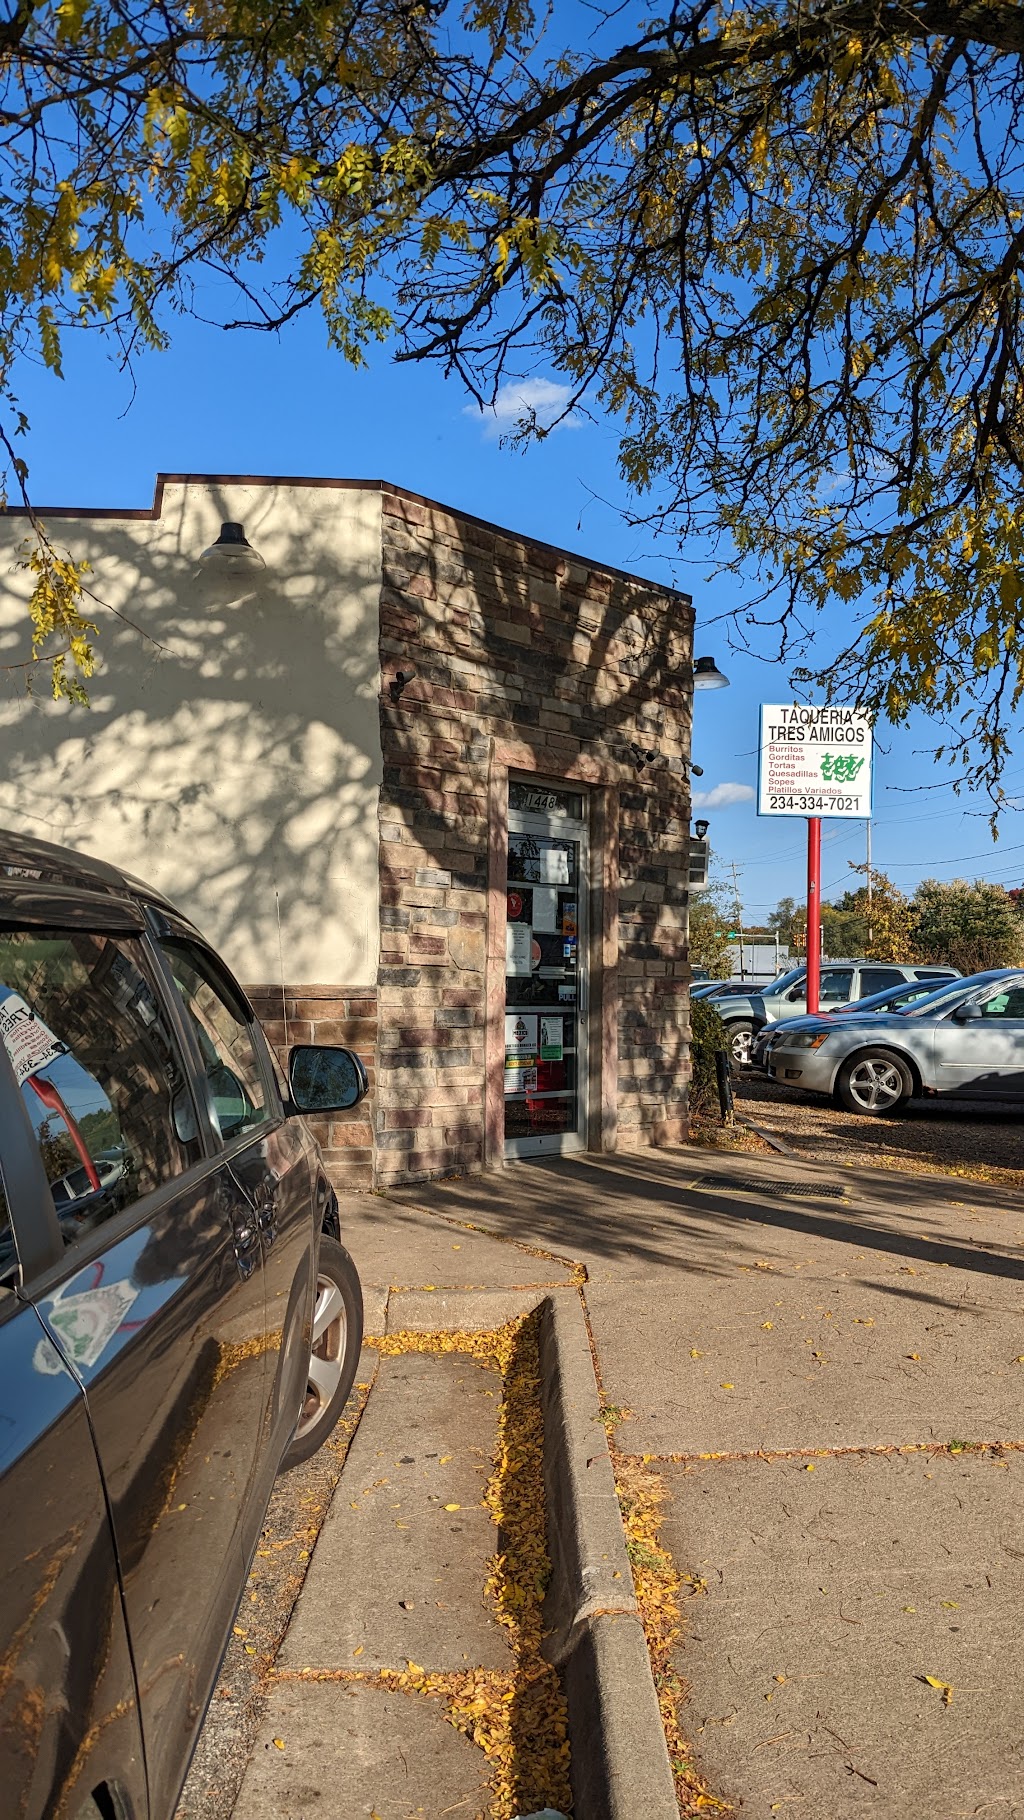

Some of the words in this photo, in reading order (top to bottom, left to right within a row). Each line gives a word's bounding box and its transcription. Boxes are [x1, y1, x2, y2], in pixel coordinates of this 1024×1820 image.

[780, 709, 853, 725] TAQUERIA
[768, 726, 805, 741] TRES
[809, 727, 865, 743] AMIGOS
[768, 753, 805, 761] Gorditas
[768, 761, 796, 769] Tortas
[768, 769, 818, 778] Quesadillas
[768, 778, 795, 786] Sopes
[768, 786, 803, 794] Platillos
[804, 787, 843, 795] Variados
[528, 794, 556, 809] 1448
[769, 796, 860, 811] 234-334-7021
[558, 993, 576, 1002] PULL
